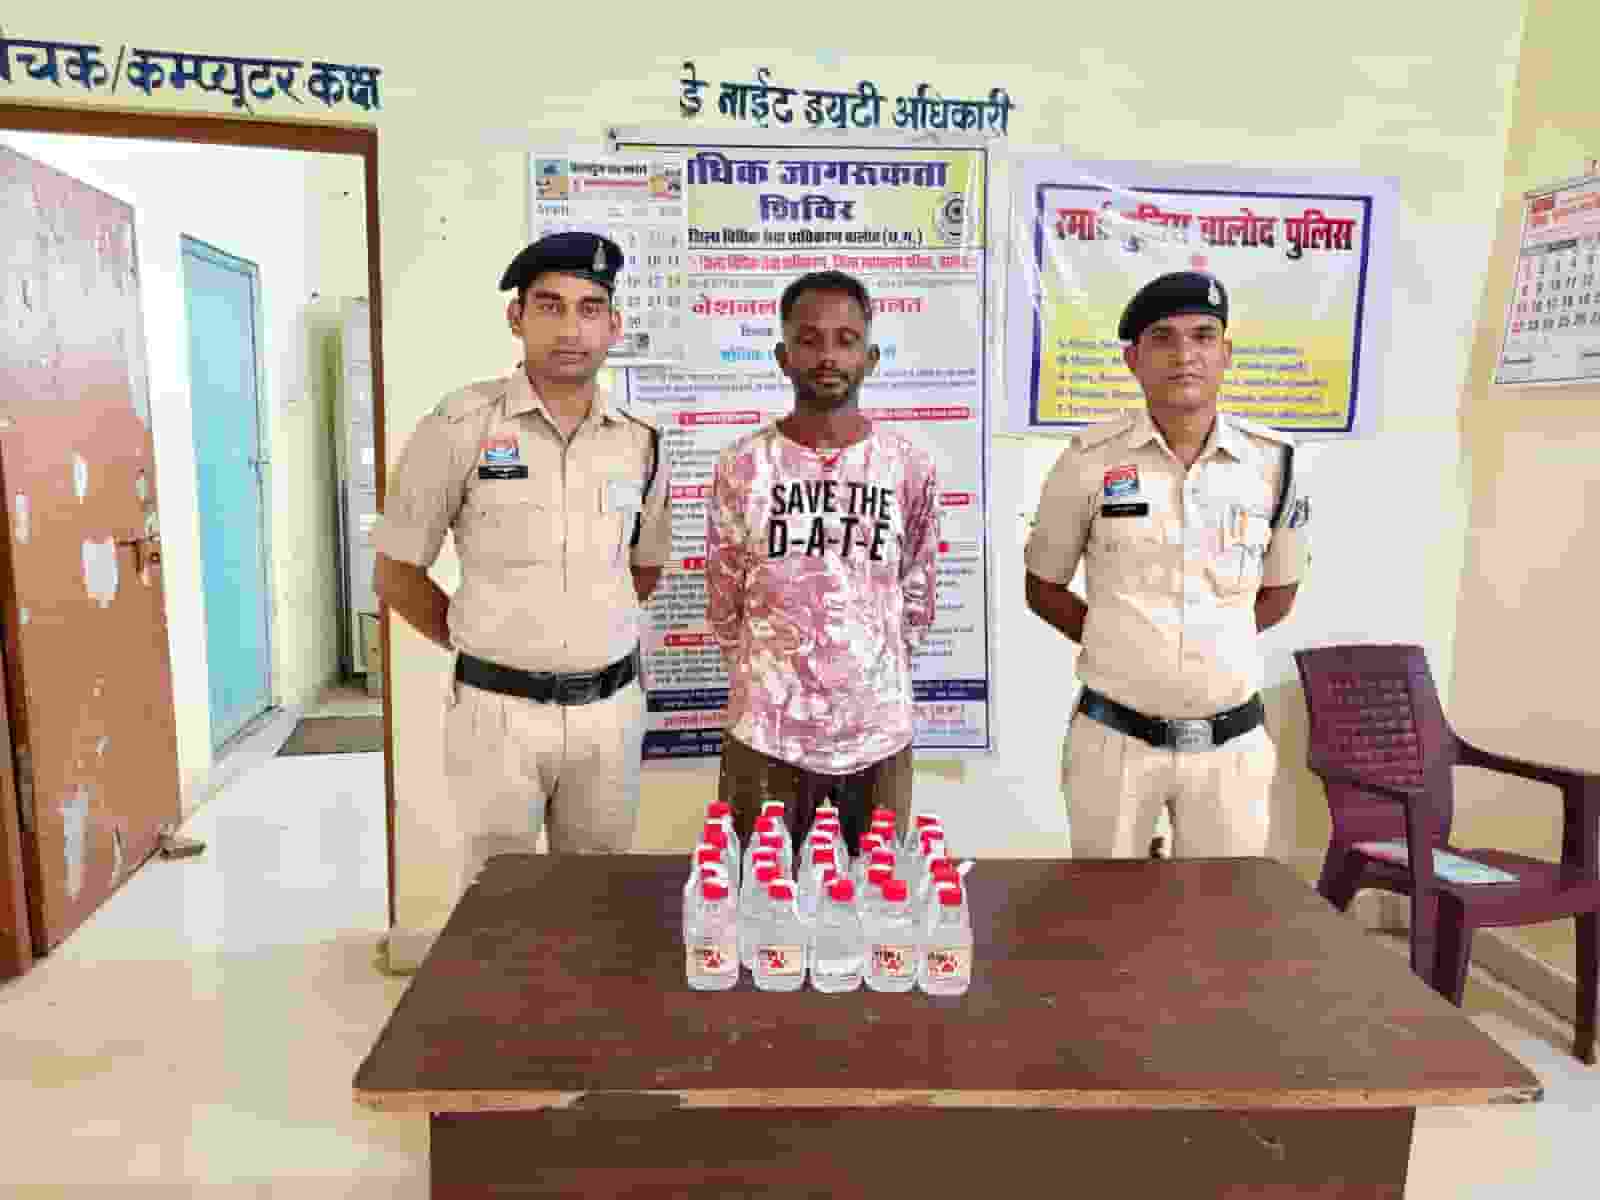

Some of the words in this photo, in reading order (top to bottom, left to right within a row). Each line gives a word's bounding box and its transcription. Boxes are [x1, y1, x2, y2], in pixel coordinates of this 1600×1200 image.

[771, 480, 838, 515] SAVE
[847, 481, 895, 520] THE
[768, 516, 890, 560] D-A-T-E
